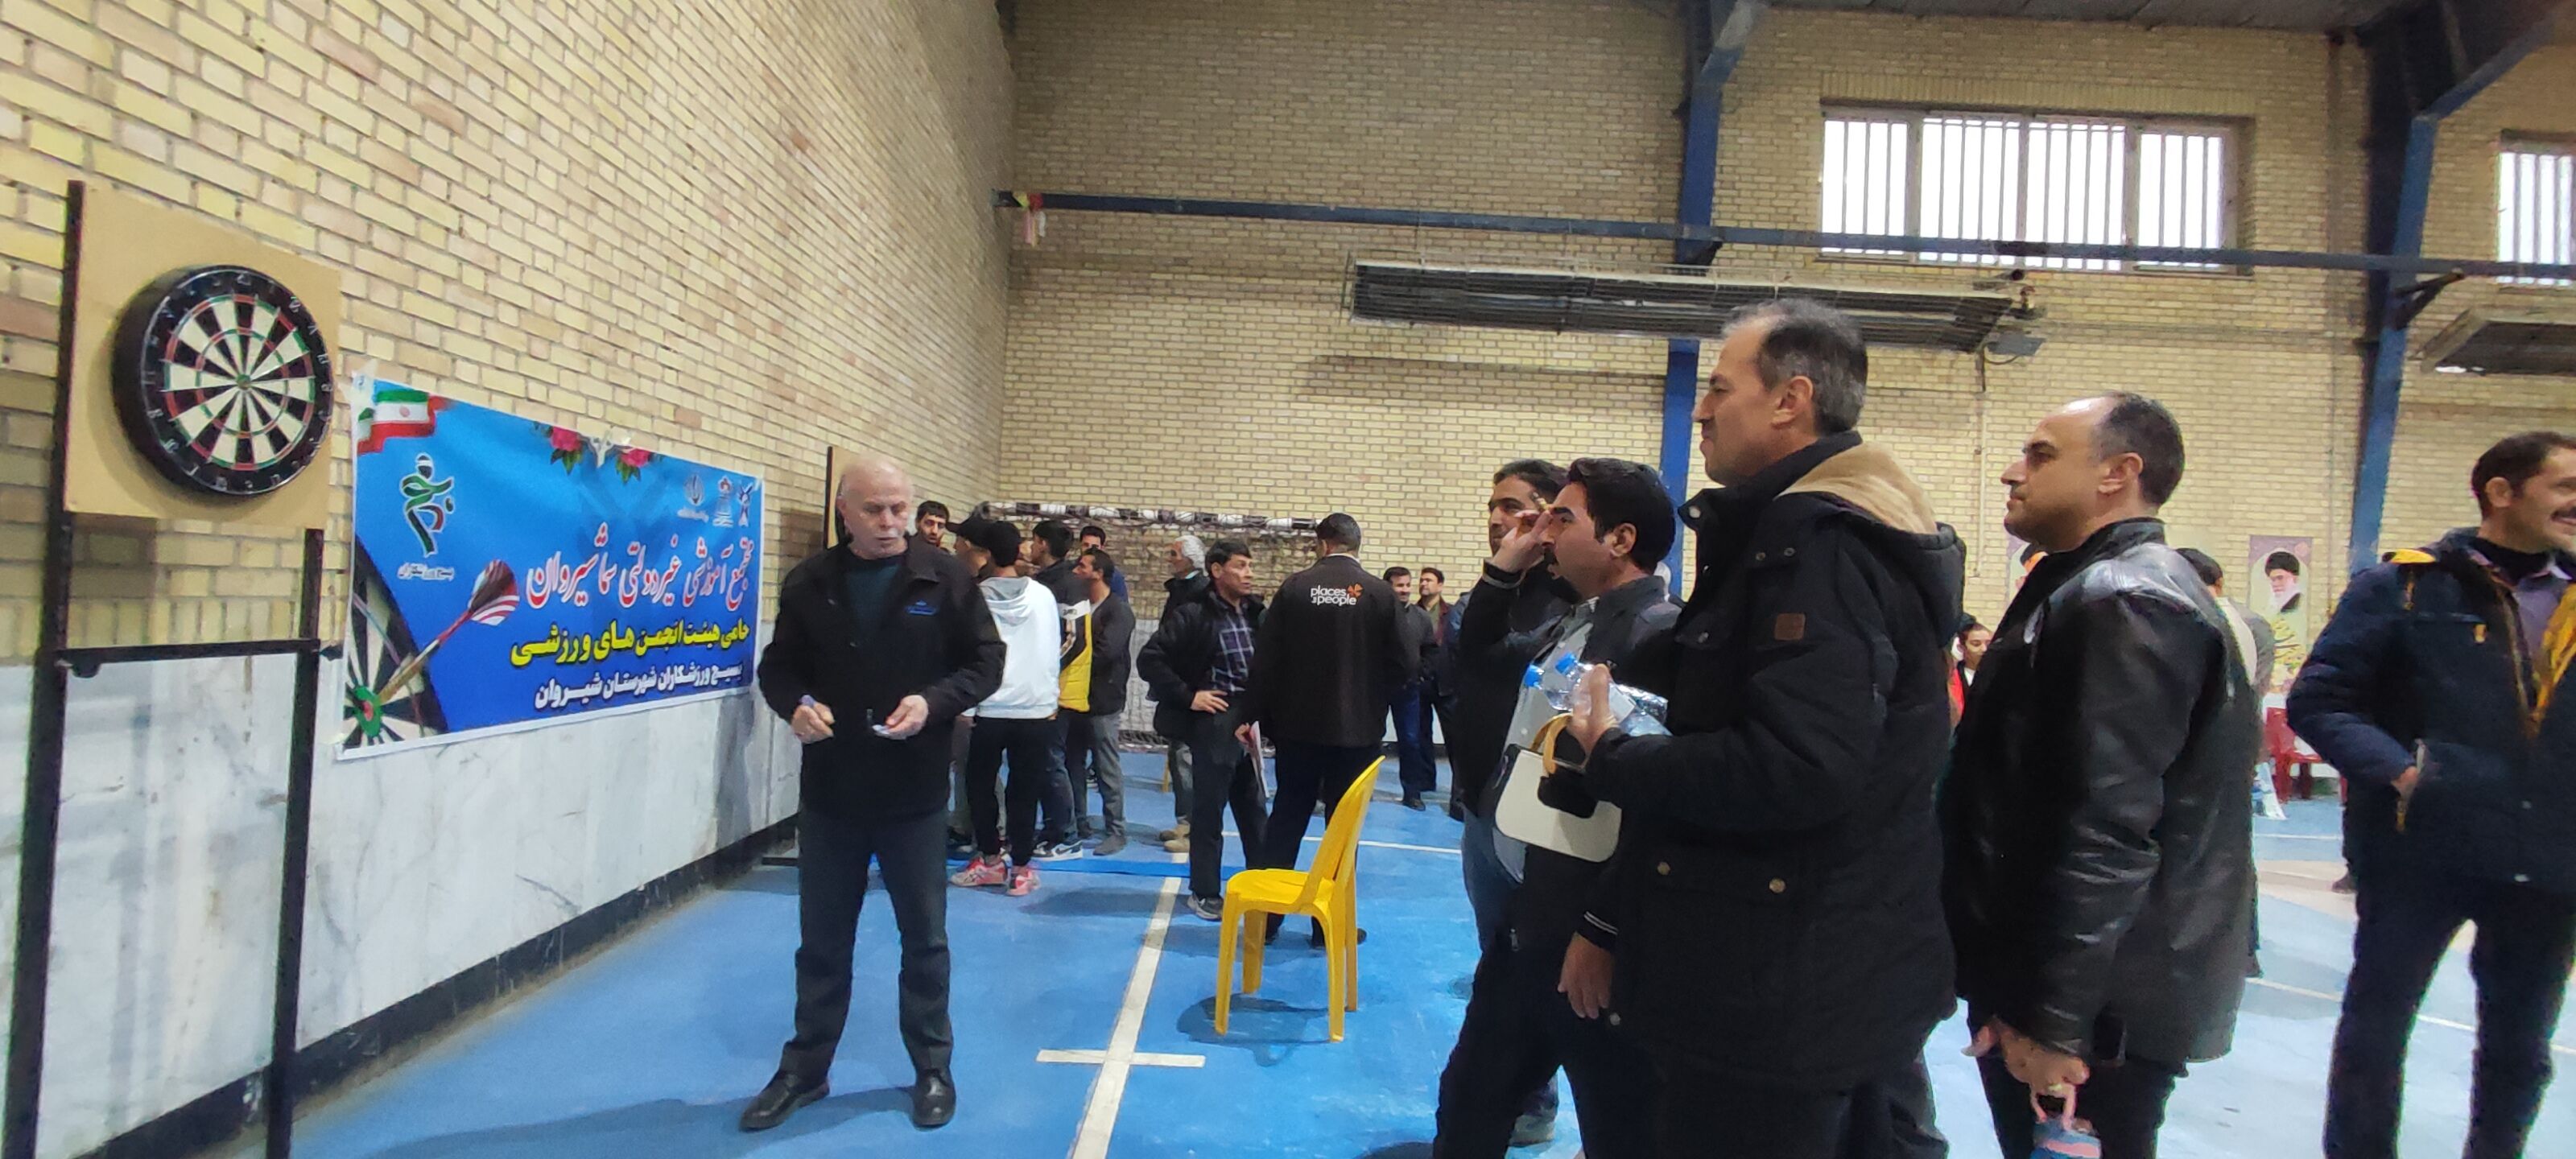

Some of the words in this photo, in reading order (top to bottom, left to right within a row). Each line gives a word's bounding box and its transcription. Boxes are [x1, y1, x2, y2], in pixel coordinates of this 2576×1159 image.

[526, 521, 609, 609] شیروان
[683, 536, 734, 608] آموزشی
[1311, 584, 1347, 598] places
[1317, 593, 1357, 607] people
[510, 624, 592, 666] ورزشی
[593, 620, 635, 660] های
[635, 618, 683, 656] انجمن
[683, 621, 720, 648] هیئت
[720, 617, 749, 649] حامی
[535, 671, 603, 709] شیروان
[602, 665, 657, 699] شهرستان
[657, 661, 711, 691] ورزشکاران
[710, 662, 743, 685] بسیج
